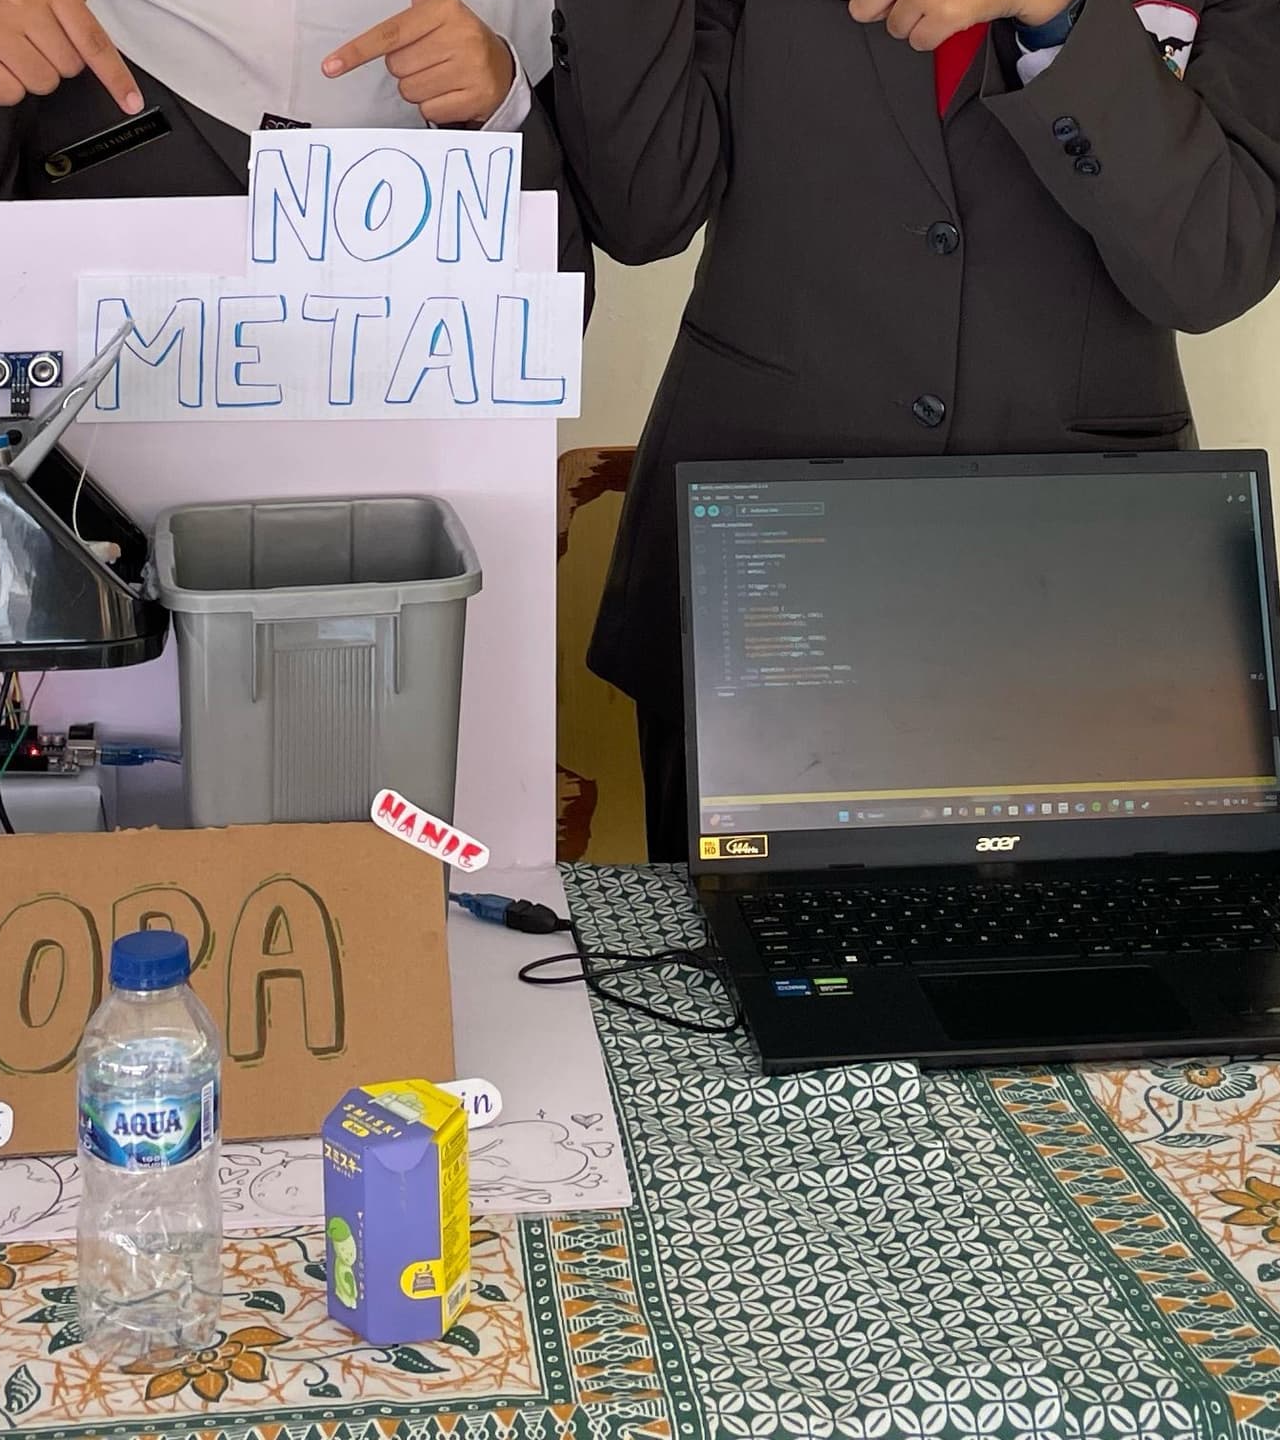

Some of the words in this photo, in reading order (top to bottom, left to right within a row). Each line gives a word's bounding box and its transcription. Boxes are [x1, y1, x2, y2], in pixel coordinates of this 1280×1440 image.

[251, 145, 513, 264] NON
[94, 294, 567, 412] METAL
[976, 836, 1020, 852] acer
[113, 1109, 182, 1140] AQUA
[343, 1103, 402, 1138] SMISKI
